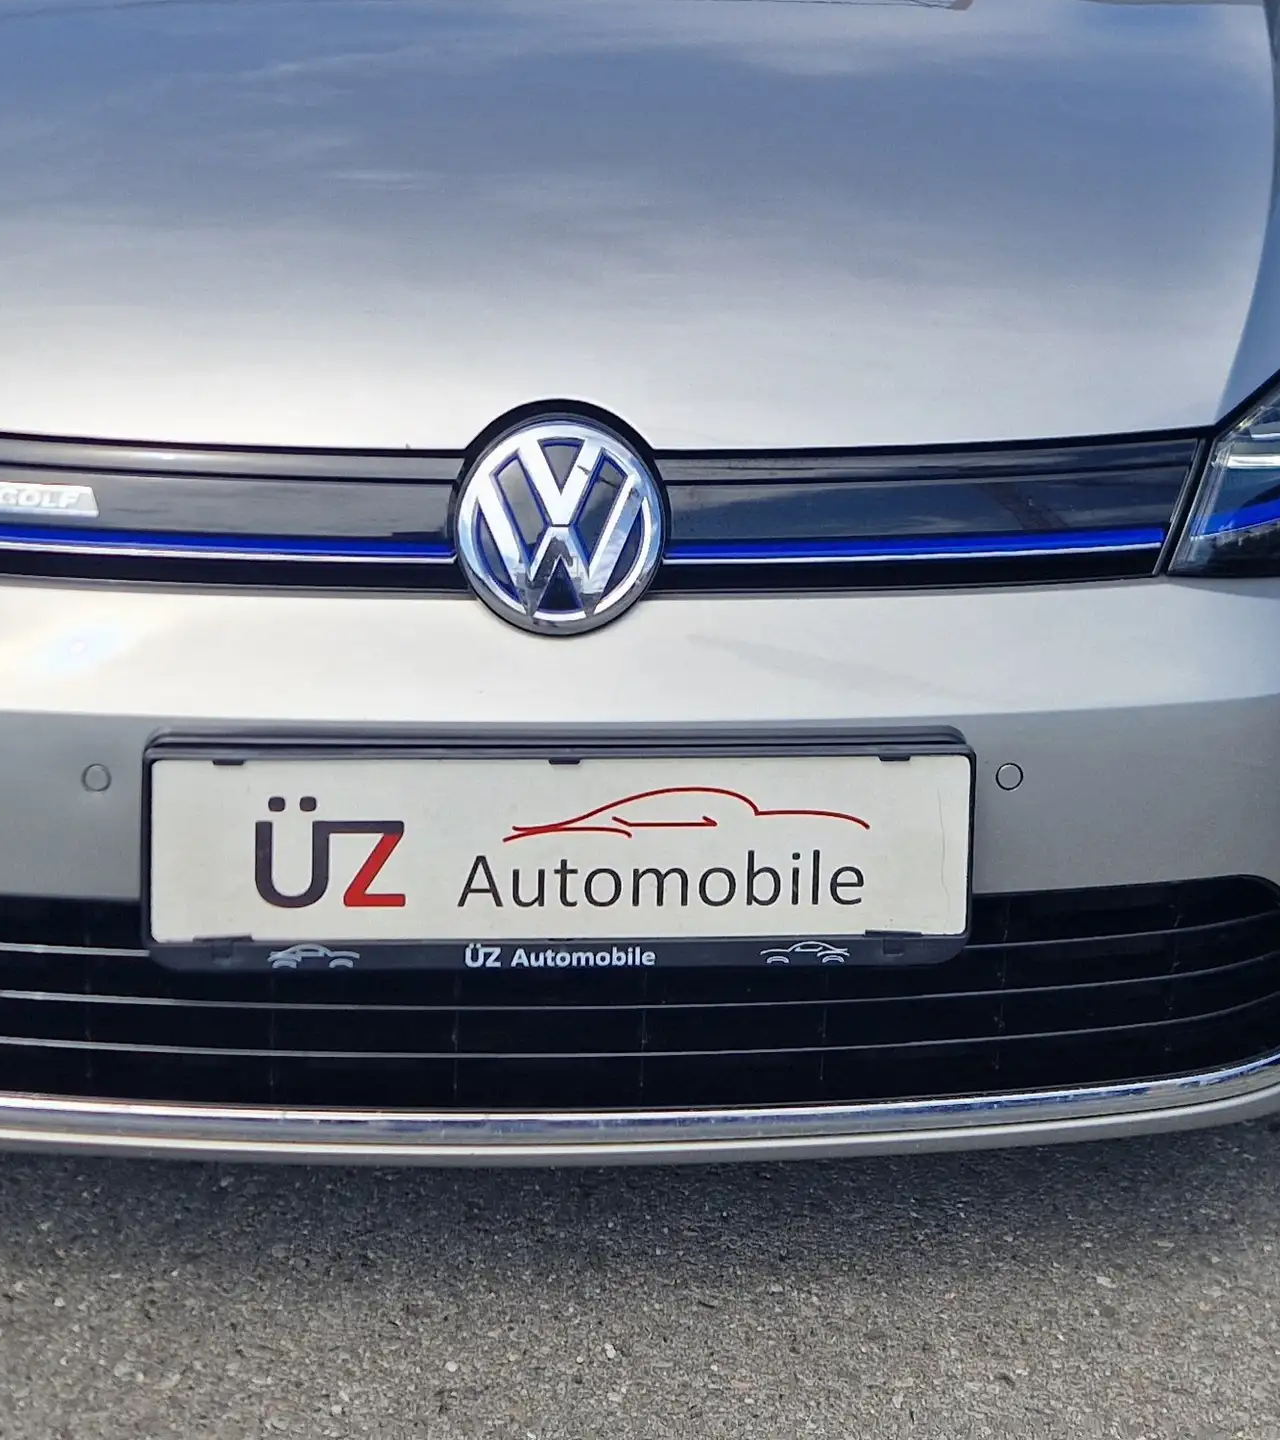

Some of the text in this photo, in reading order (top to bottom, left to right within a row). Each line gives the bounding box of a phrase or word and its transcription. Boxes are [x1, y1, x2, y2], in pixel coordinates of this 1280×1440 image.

[465, 426, 660, 622] VW
[254, 795, 867, 909] ÜZ Automobile
[465, 942, 657, 968] ÜZ Automobile
